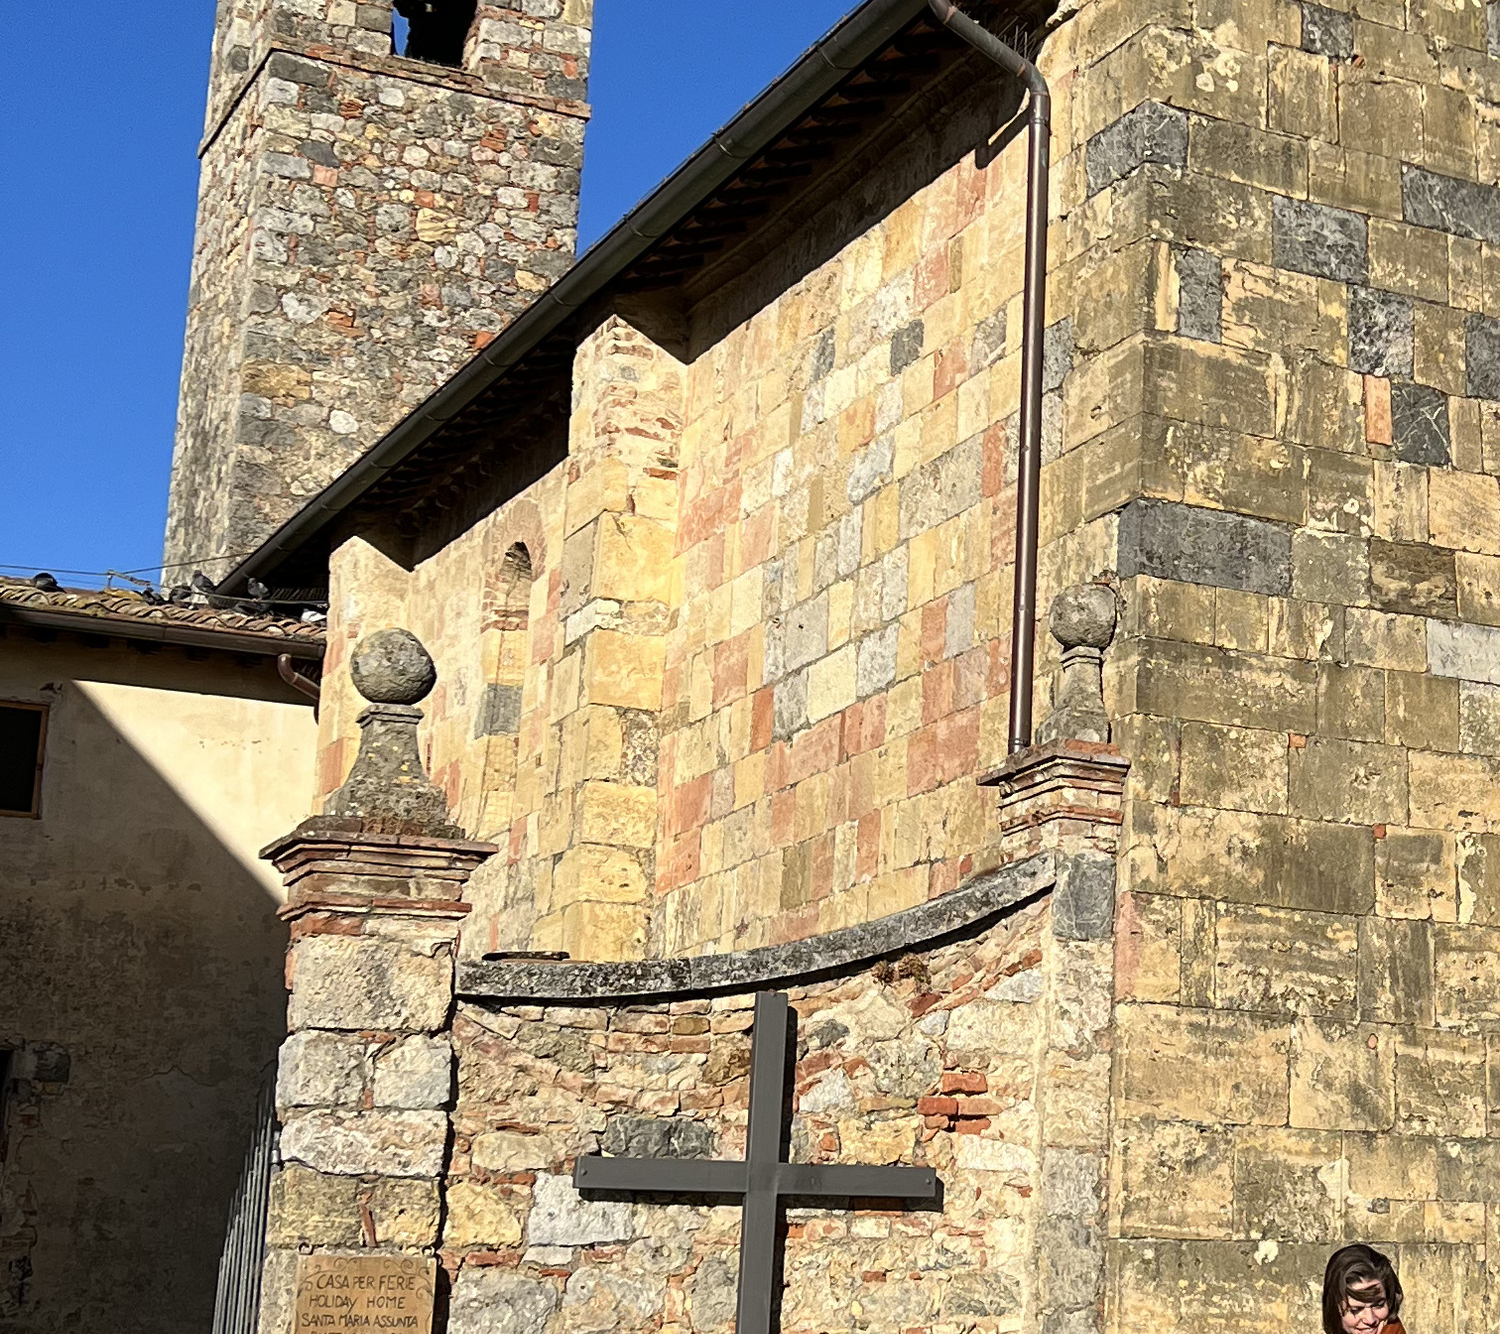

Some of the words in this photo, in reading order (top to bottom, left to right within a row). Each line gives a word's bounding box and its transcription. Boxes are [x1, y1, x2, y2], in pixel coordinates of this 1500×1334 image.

[317, 1274, 350, 1289] CASA
[353, 1275, 375, 1289] PER
[379, 1274, 416, 1290] FERIE
[309, 1295, 358, 1314] HOLIDAY
[366, 1296, 406, 1309] HOME
[301, 1313, 335, 1327] SANTA
[338, 1314, 370, 1327] MARIA
[374, 1315, 418, 1328] ASSUNTA
